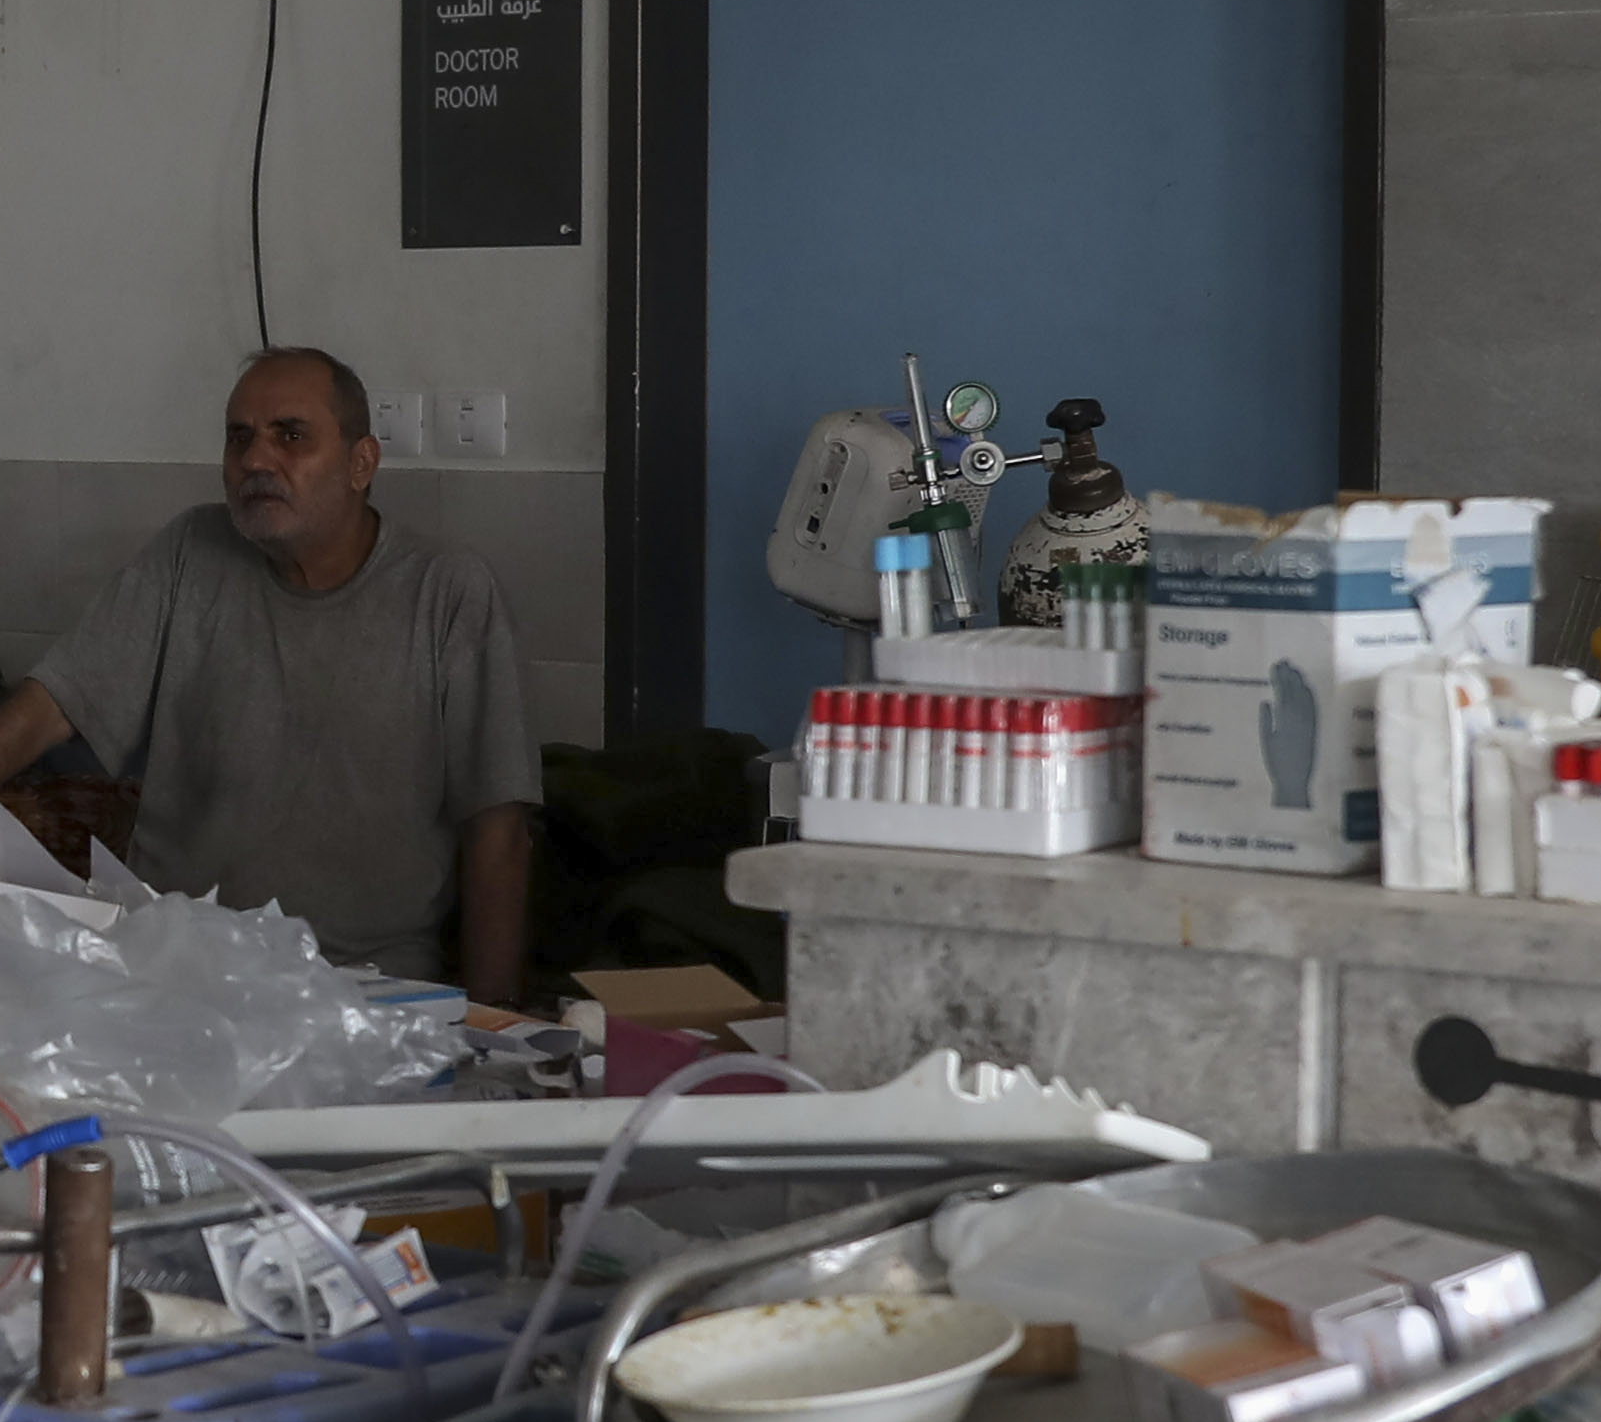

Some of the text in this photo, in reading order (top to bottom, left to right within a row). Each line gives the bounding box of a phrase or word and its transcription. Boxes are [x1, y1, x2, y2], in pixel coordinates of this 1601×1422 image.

[434, 46, 520, 75] DOCTOR
[434, 83, 498, 110] ROOM
[1200, 550, 1322, 580] GLOVES
[1158, 622, 1230, 650] Storage
